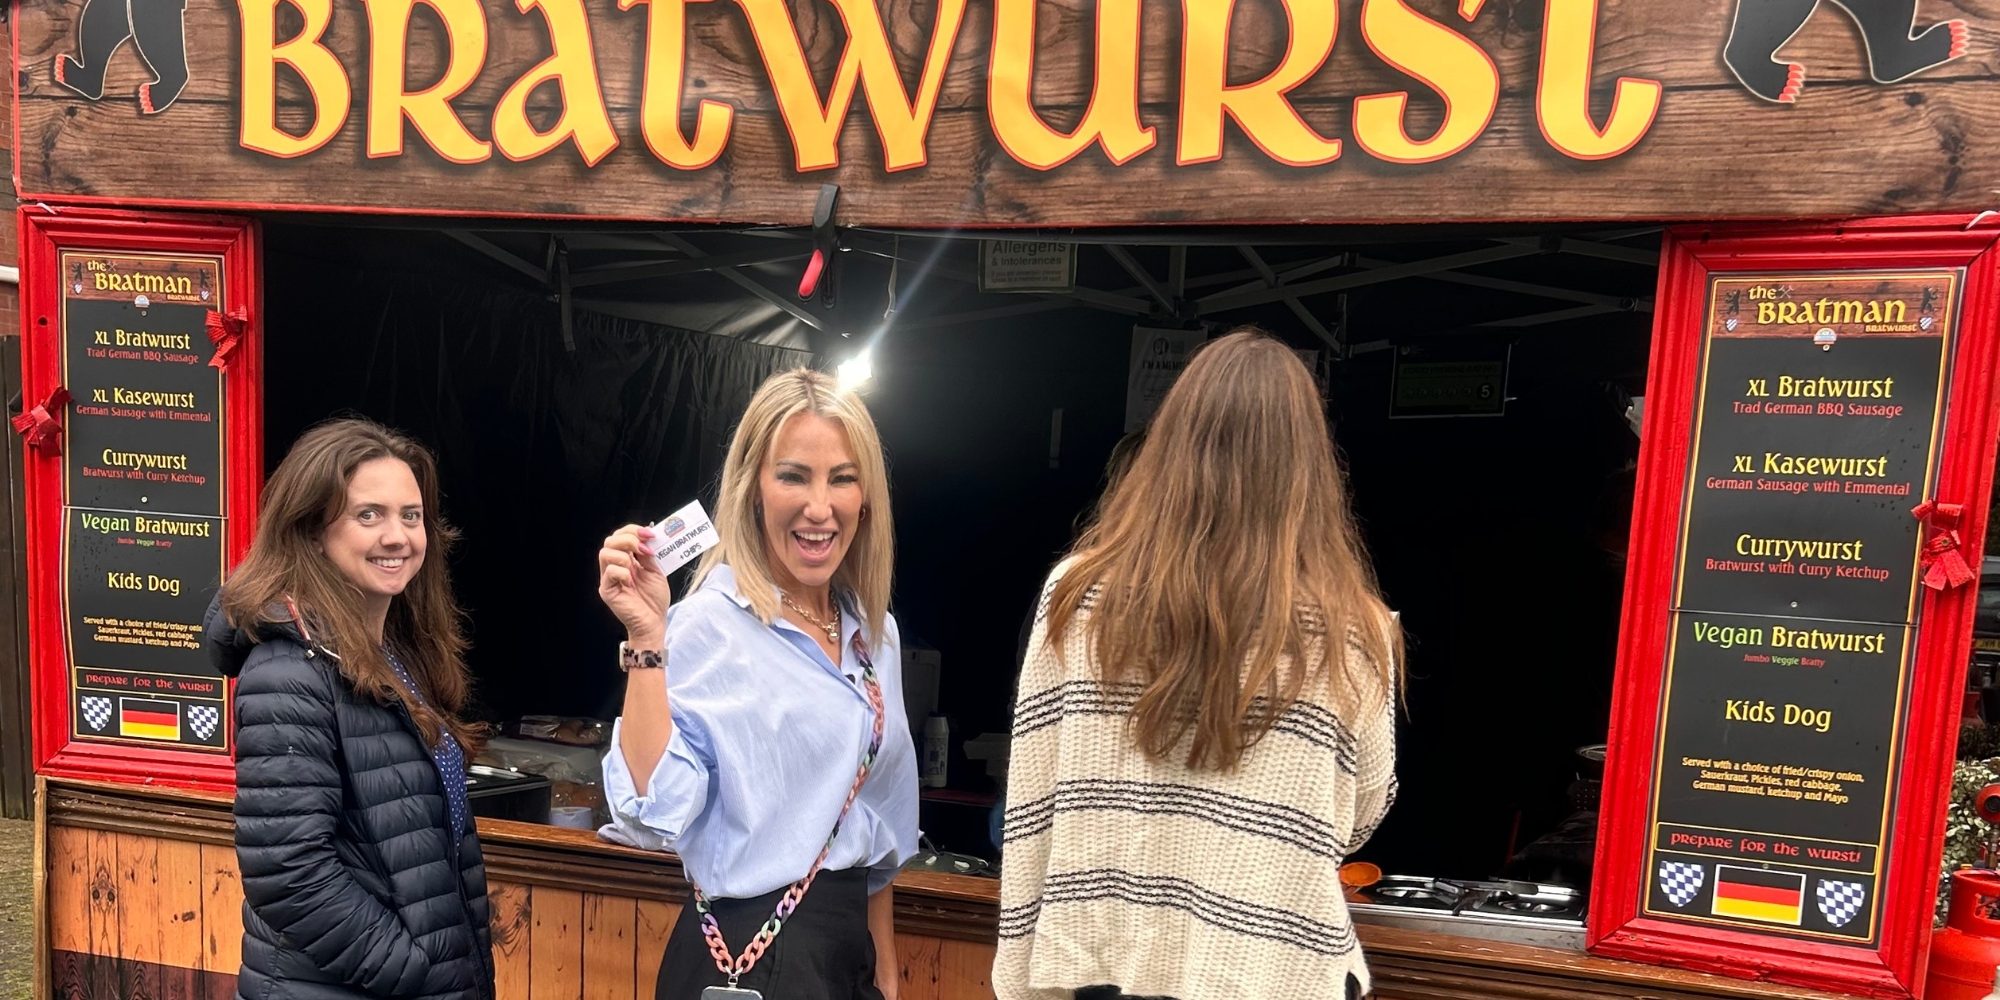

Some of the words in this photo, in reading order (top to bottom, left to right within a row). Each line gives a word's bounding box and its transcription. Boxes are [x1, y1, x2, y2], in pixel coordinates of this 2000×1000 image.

[87, 260, 106, 271] the
[1748, 285, 1777, 300] the
[95, 331, 110, 345] XL
[116, 329, 190, 350] Bratwurst
[87, 348, 106, 358] Trad
[108, 349, 141, 360] German
[143, 350, 161, 362] BBQ
[163, 352, 199, 365] Sausage
[1480, 384, 1491, 398] 5
[1746, 379, 1769, 397] XL
[1778, 375, 1893, 398] Bratwurst
[93, 389, 109, 402] XL
[114, 387, 194, 408] Kasewurst
[76, 404, 108, 416] German
[111, 406, 146, 420] Sausage
[149, 409, 166, 419] with
[169, 410, 211, 422] Emmental
[1733, 401, 1760, 414] Trad
[1764, 401, 1812, 415] German
[1817, 402, 1843, 417] BBQ
[1848, 403, 1903, 418] Sausage
[102, 449, 187, 470] Currywurst
[1732, 455, 1755, 473] XL
[1764, 452, 1888, 477] Kasewurst
[83, 467, 123, 479] Bratwurst
[127, 470, 144, 480] with
[146, 471, 168, 483] Curry
[171, 472, 205, 486] Ketchup
[1706, 477, 1752, 490] German
[1756, 479, 1809, 494] Sausage
[1813, 480, 1840, 493] with
[1844, 481, 1911, 496] Emmental
[81, 513, 130, 534] Vegan
[135, 516, 210, 537] Bratwurst
[655, 542, 677, 561] VEGAN
[674, 521, 711, 549] BRATWURST
[683, 542, 703, 558] CHIPS
[1735, 533, 1863, 562] Currywurst
[1705, 558, 1764, 573] Bratwurst
[1768, 561, 1795, 575] with
[1799, 563, 1832, 579] Curry
[1835, 564, 1889, 581] Ketchup
[107, 572, 143, 590] Kids
[148, 575, 180, 596] Dog
[83, 616, 104, 625] Served
[105, 617, 118, 626] with
[145, 620, 152, 628] of
[155, 629, 166, 638] red
[1693, 621, 1763, 649] Vegan
[1771, 625, 1885, 654] Bratwurst
[170, 639, 182, 647] and
[183, 640, 200, 650] Mayo
[1744, 654, 1770, 663] Jumbo
[1771, 655, 1799, 666] Veggie
[155, 678, 173, 689] the
[1725, 699, 1776, 723] Kids
[1783, 703, 1832, 733] Dog
[1682, 757, 1712, 768] Served
[1713, 759, 1732, 770] with
[1733, 762, 1740, 770] a
[1741, 762, 1769, 774] choice
[1771, 764, 1782, 774] of
[1782, 764, 1835, 781] fried/crispy
[1836, 771, 1865, 783] onion,
[1700, 769, 1749, 783] Sauerkraut,
[1750, 774, 1783, 786] Pickles,
[1785, 777, 1800, 788] red
[1801, 778, 1842, 793] cabbage,
[1692, 780, 1726, 792] German
[1727, 783, 1765, 796] mustard,
[1767, 786, 1802, 800] ketchup
[1804, 790, 1822, 801] and
[1823, 793, 1849, 805] Mayo
[1773, 842, 1799, 856] the
